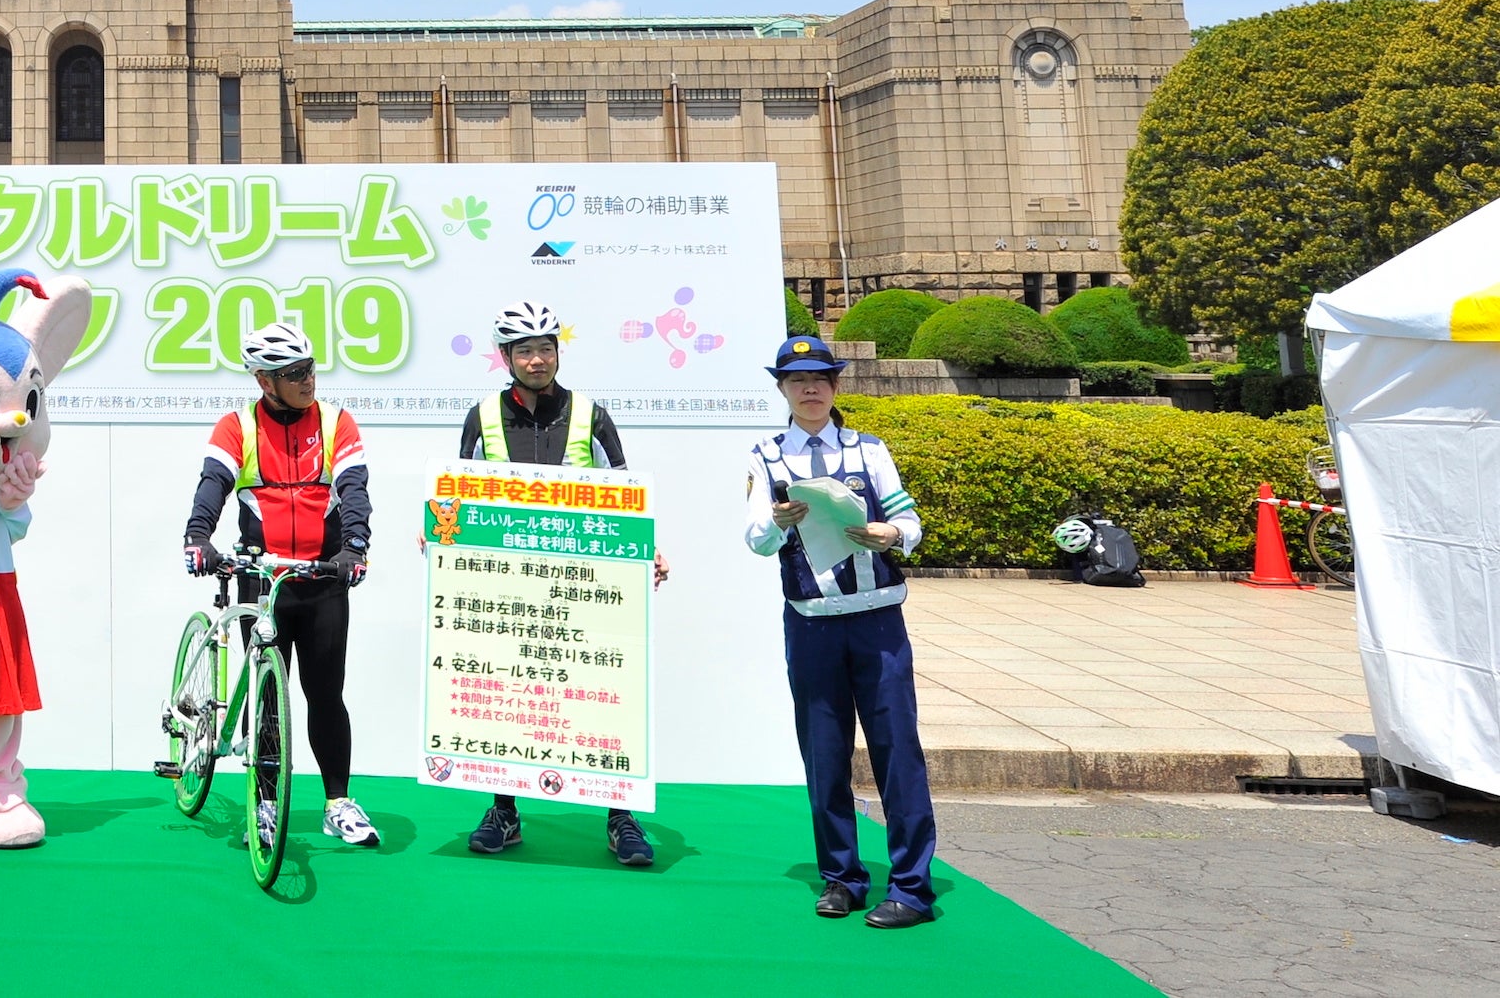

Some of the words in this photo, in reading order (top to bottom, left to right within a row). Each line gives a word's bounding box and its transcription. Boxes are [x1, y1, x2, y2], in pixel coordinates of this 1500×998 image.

[583, 195, 730, 215] 競輪の補助事業
[144, 276, 415, 374] 2019
[591, 398, 769, 412] 康日本21推進全国連絡協議会
[436, 474, 645, 512] 自転車安全利用五則
[466, 509, 620, 536] 正しいルールを知り、安全に
[502, 534, 649, 558] 自転車を利用しましょう！
[454, 556, 601, 583] 自転車は、車道が原則、
[549, 585, 624, 606] 歩道は例外
[453, 596, 570, 621] 車道は左側を通行
[453, 616, 591, 643] 歩道は歩行者優先で、
[519, 643, 624, 668] 車道寄りを徐行
[452, 657, 569, 682] 安全ルールを守る
[460, 692, 561, 713] 夜間はライトを点灯
[460, 707, 572, 729] 交差点での信号遵守と
[522, 731, 621, 751] 一時停止・安全確認
[450, 736, 631, 772] 子どもはヘルメットを着用
